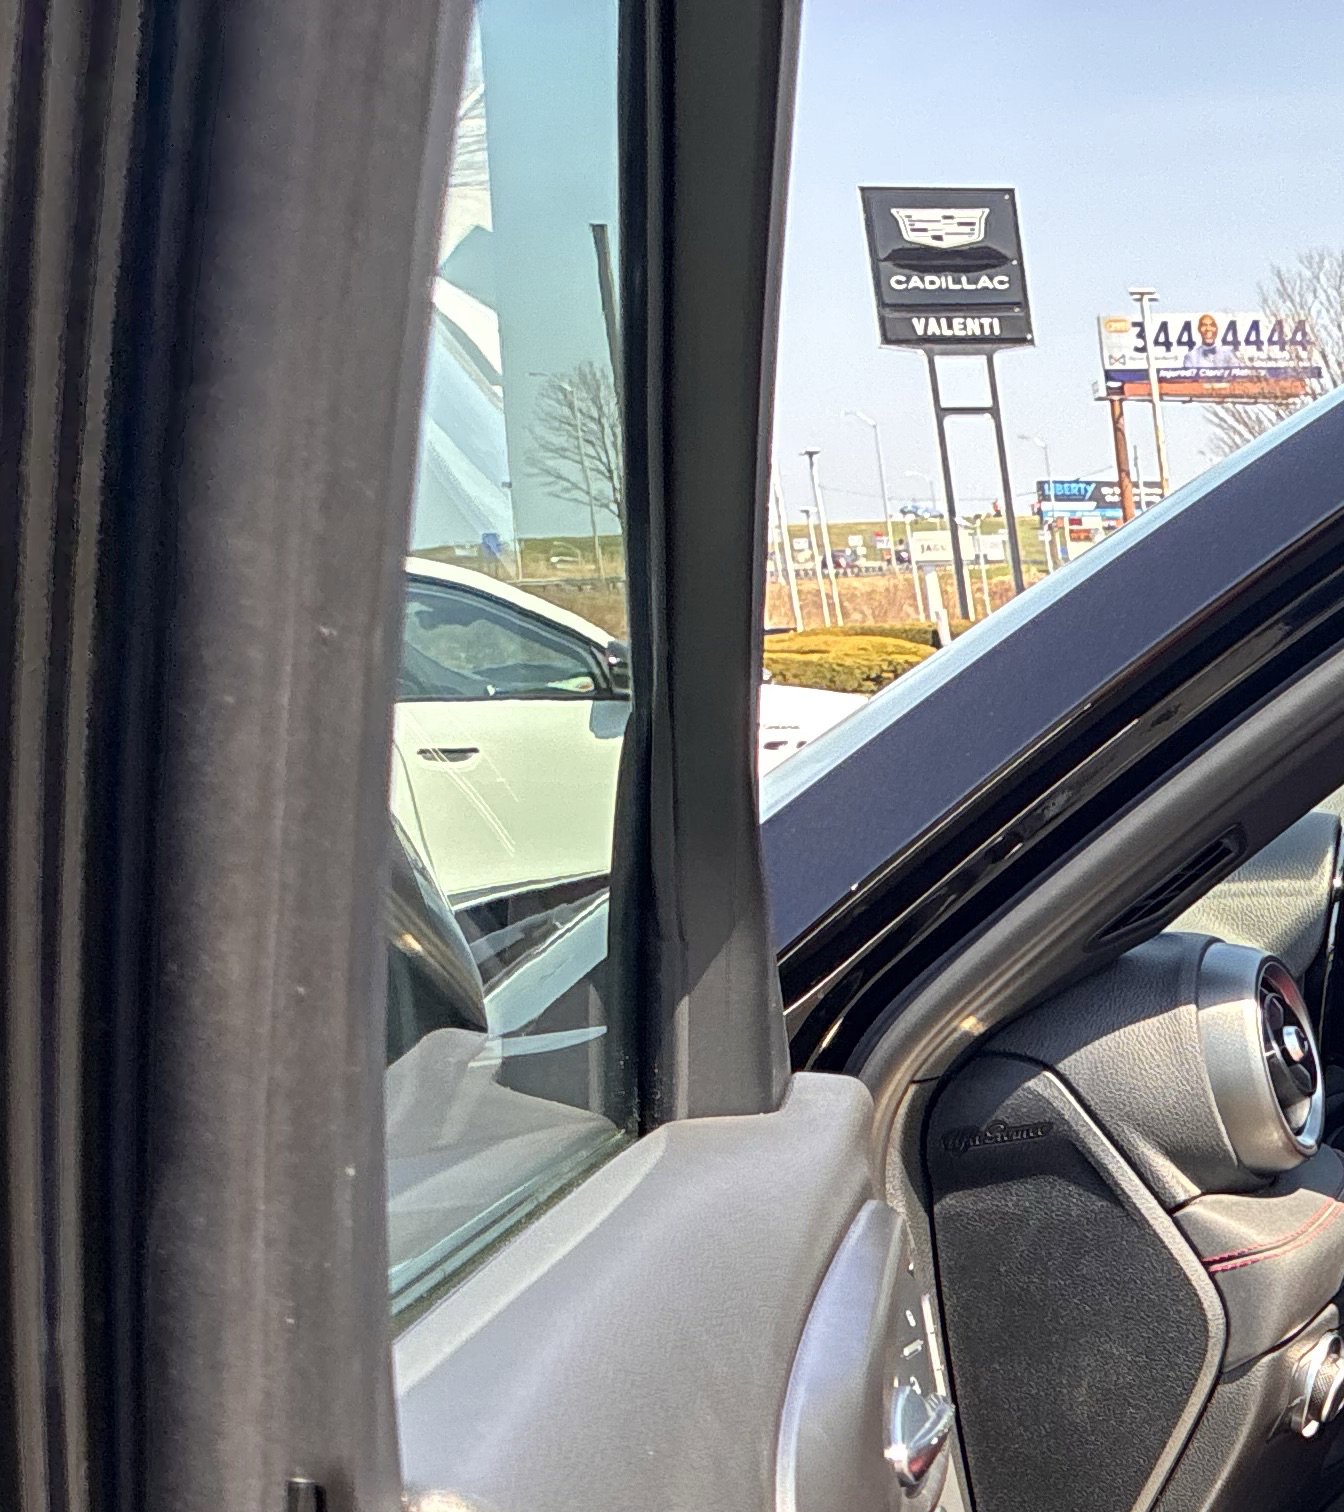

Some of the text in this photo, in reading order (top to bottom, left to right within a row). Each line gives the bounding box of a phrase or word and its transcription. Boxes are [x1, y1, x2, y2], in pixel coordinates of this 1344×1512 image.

[890, 275, 1009, 290] CADILLAC
[911, 317, 1001, 336] VALENTI
[1043, 483, 1096, 500] LBERTY
